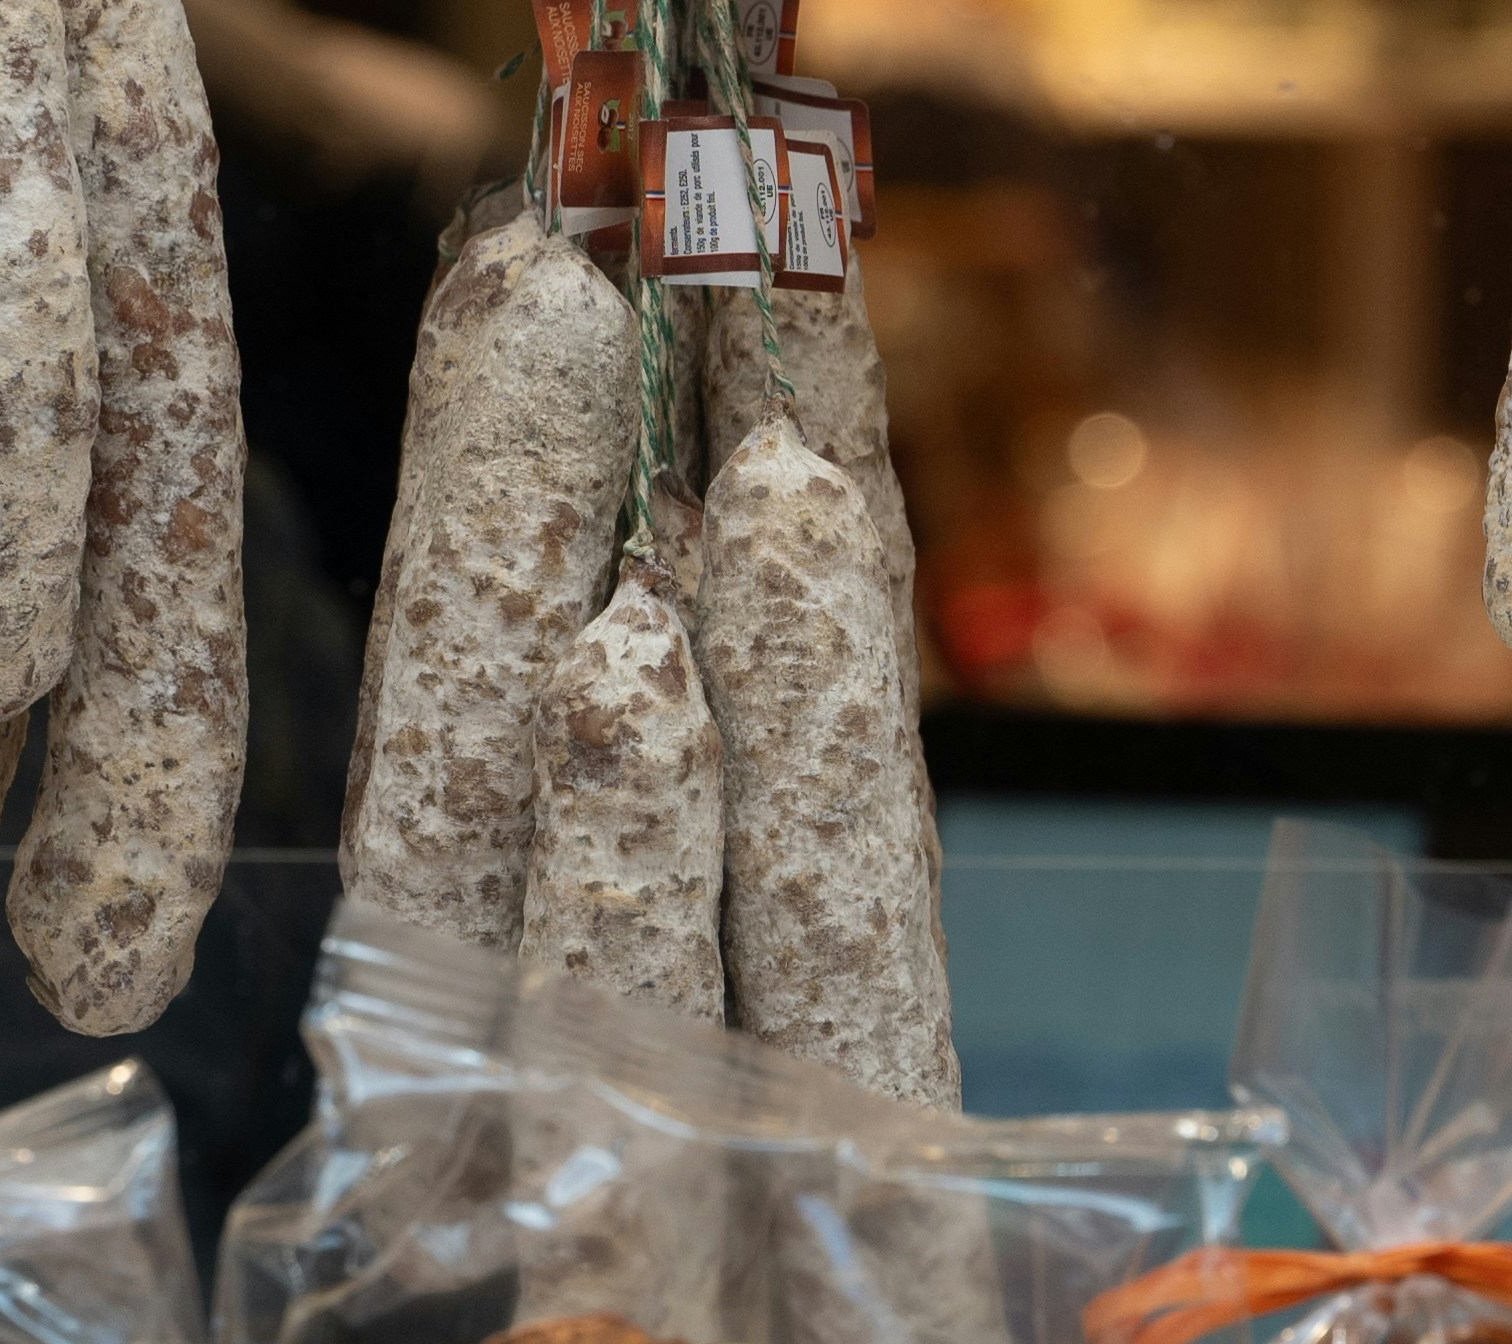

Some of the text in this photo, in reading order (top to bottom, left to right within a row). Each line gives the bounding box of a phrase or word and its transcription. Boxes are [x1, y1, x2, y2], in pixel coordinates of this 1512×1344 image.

[568, 81, 584, 172] AUX NOISETTES
[575, 81, 592, 173] SAUCISSON SEC
[690, 132, 699, 147] pour
[706, 203, 719, 226] produit
[708, 227, 717, 236] de
